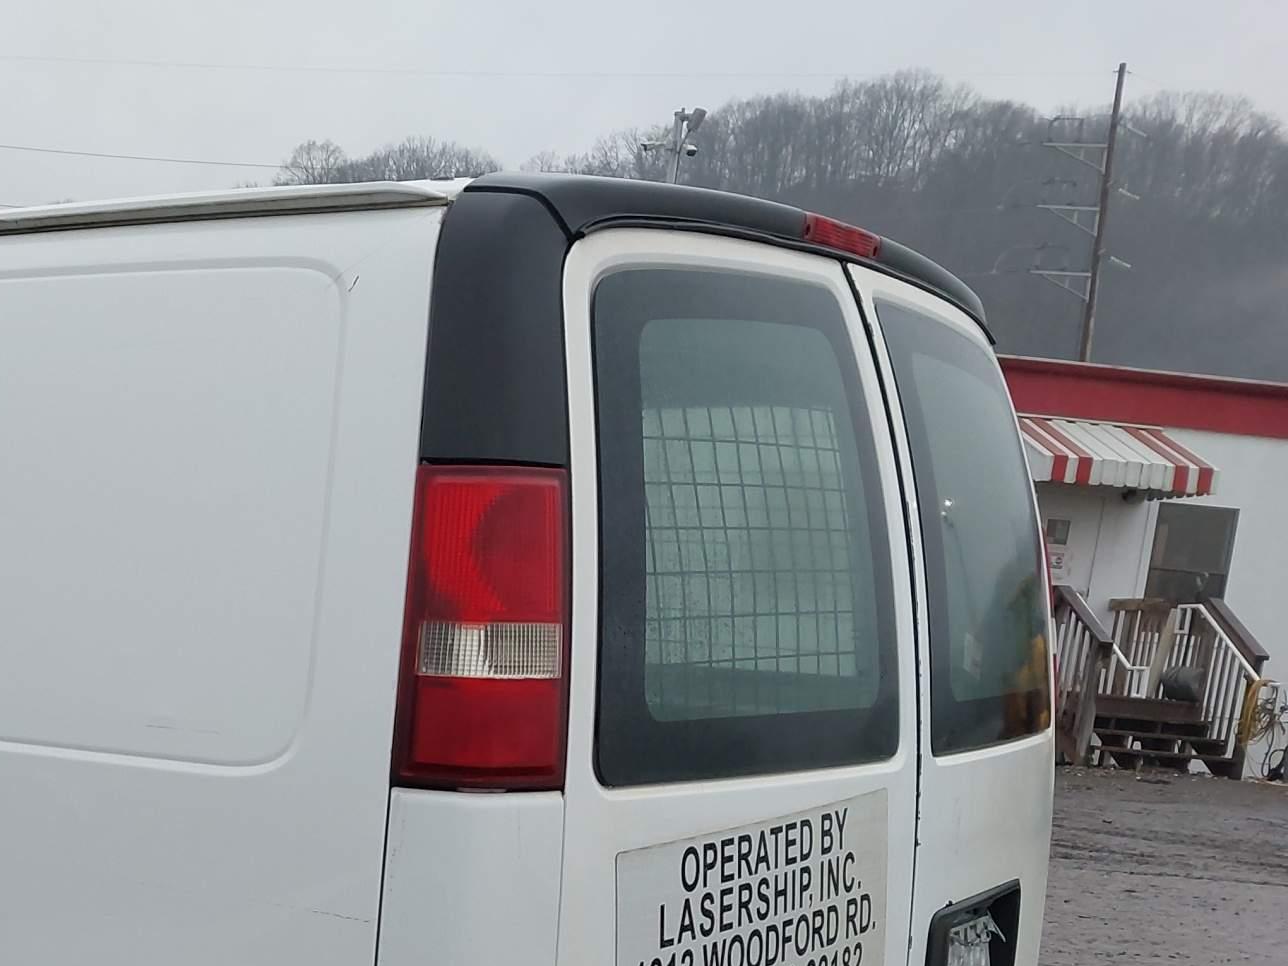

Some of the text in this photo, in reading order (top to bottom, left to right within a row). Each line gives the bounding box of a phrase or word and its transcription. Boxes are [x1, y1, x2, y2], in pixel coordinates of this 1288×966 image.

[681, 808, 848, 892] OPERATED BY
[660, 852, 861, 948] LASERSHIP, INC.
[845, 894, 876, 939] RD.
